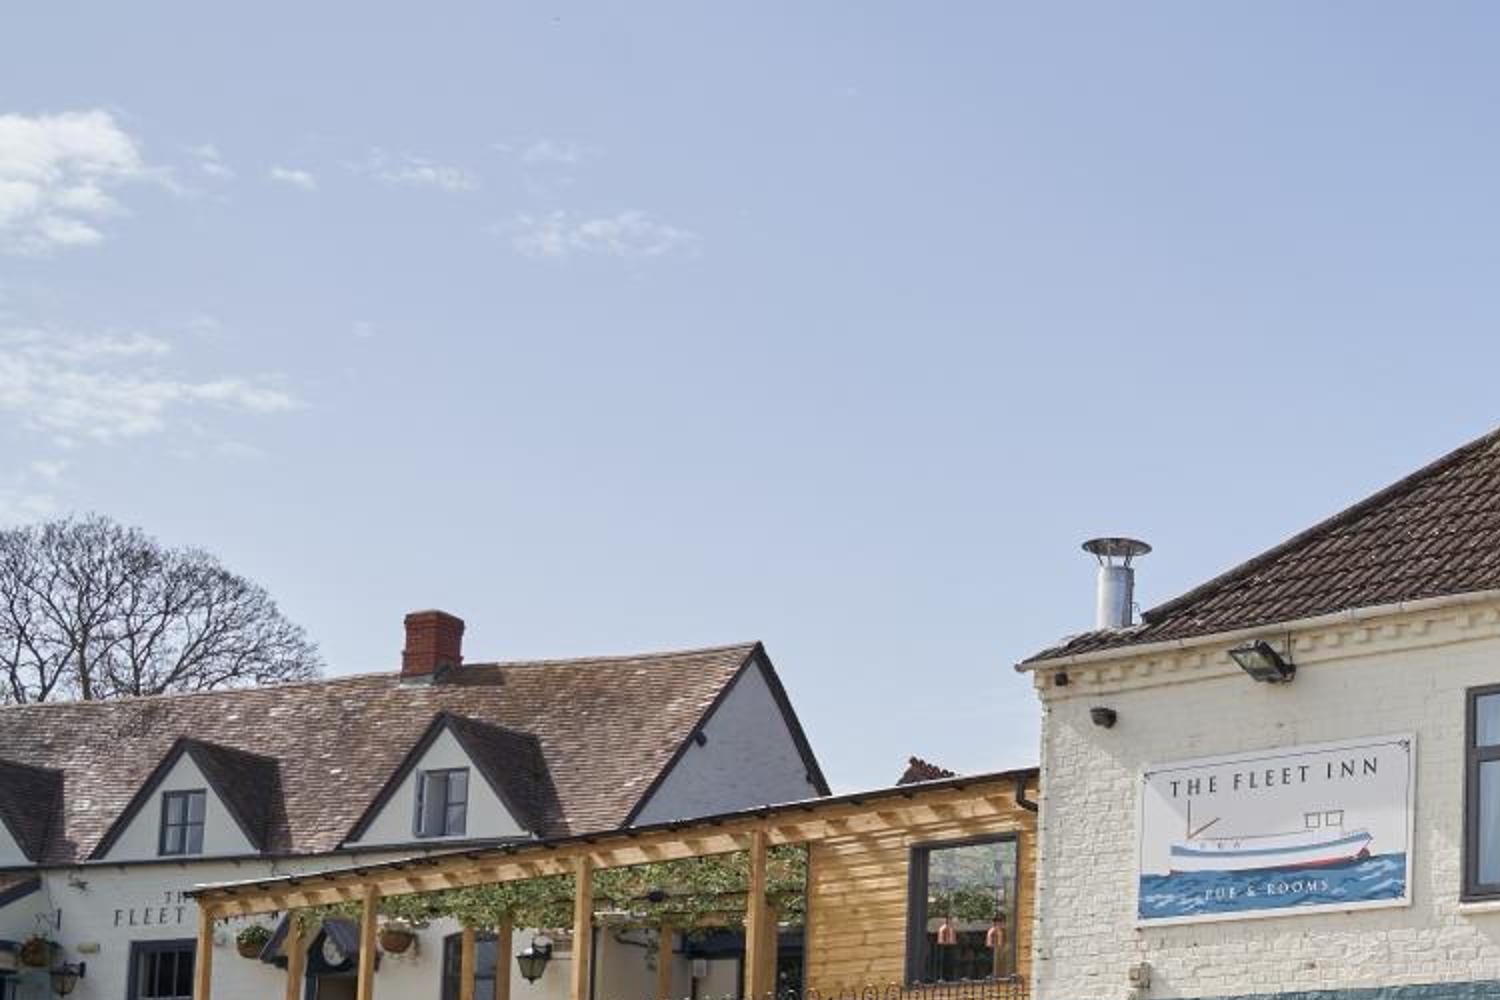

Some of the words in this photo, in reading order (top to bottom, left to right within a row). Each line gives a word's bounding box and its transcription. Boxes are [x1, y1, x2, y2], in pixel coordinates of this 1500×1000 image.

[1170, 776, 1217, 798] THE
[1233, 765, 1310, 790] FLEET
[1327, 757, 1378, 779] INN
[1205, 886, 1237, 900] PUB
[1267, 879, 1329, 895] ROOMS
[113, 907, 183, 926] FLEET
